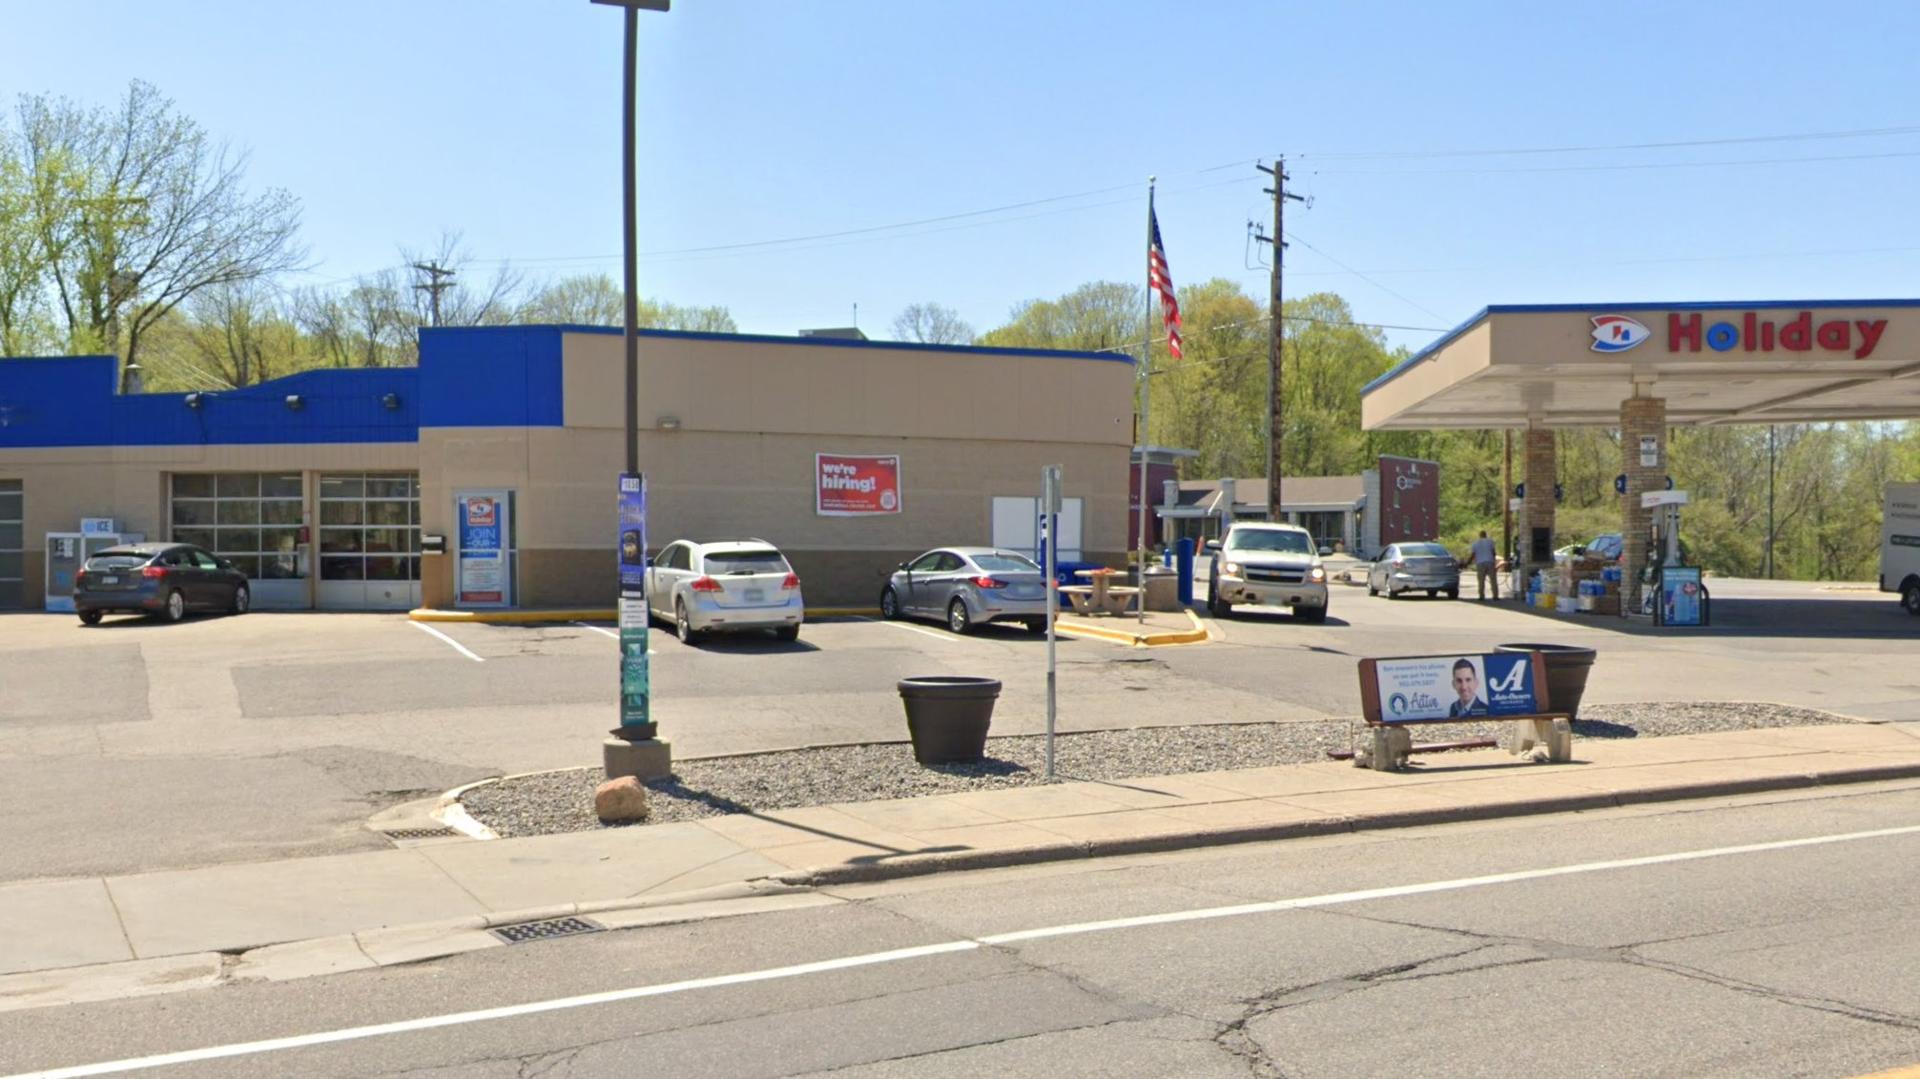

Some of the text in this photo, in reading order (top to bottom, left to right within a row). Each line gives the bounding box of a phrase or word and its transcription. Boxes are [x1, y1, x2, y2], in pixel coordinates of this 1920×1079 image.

[1667, 311, 1889, 360] Holiday
[822, 463, 856, 475] we're
[822, 474, 876, 493] hiring!
[96, 521, 109, 532] ICE
[466, 528, 496, 540] JOIN
